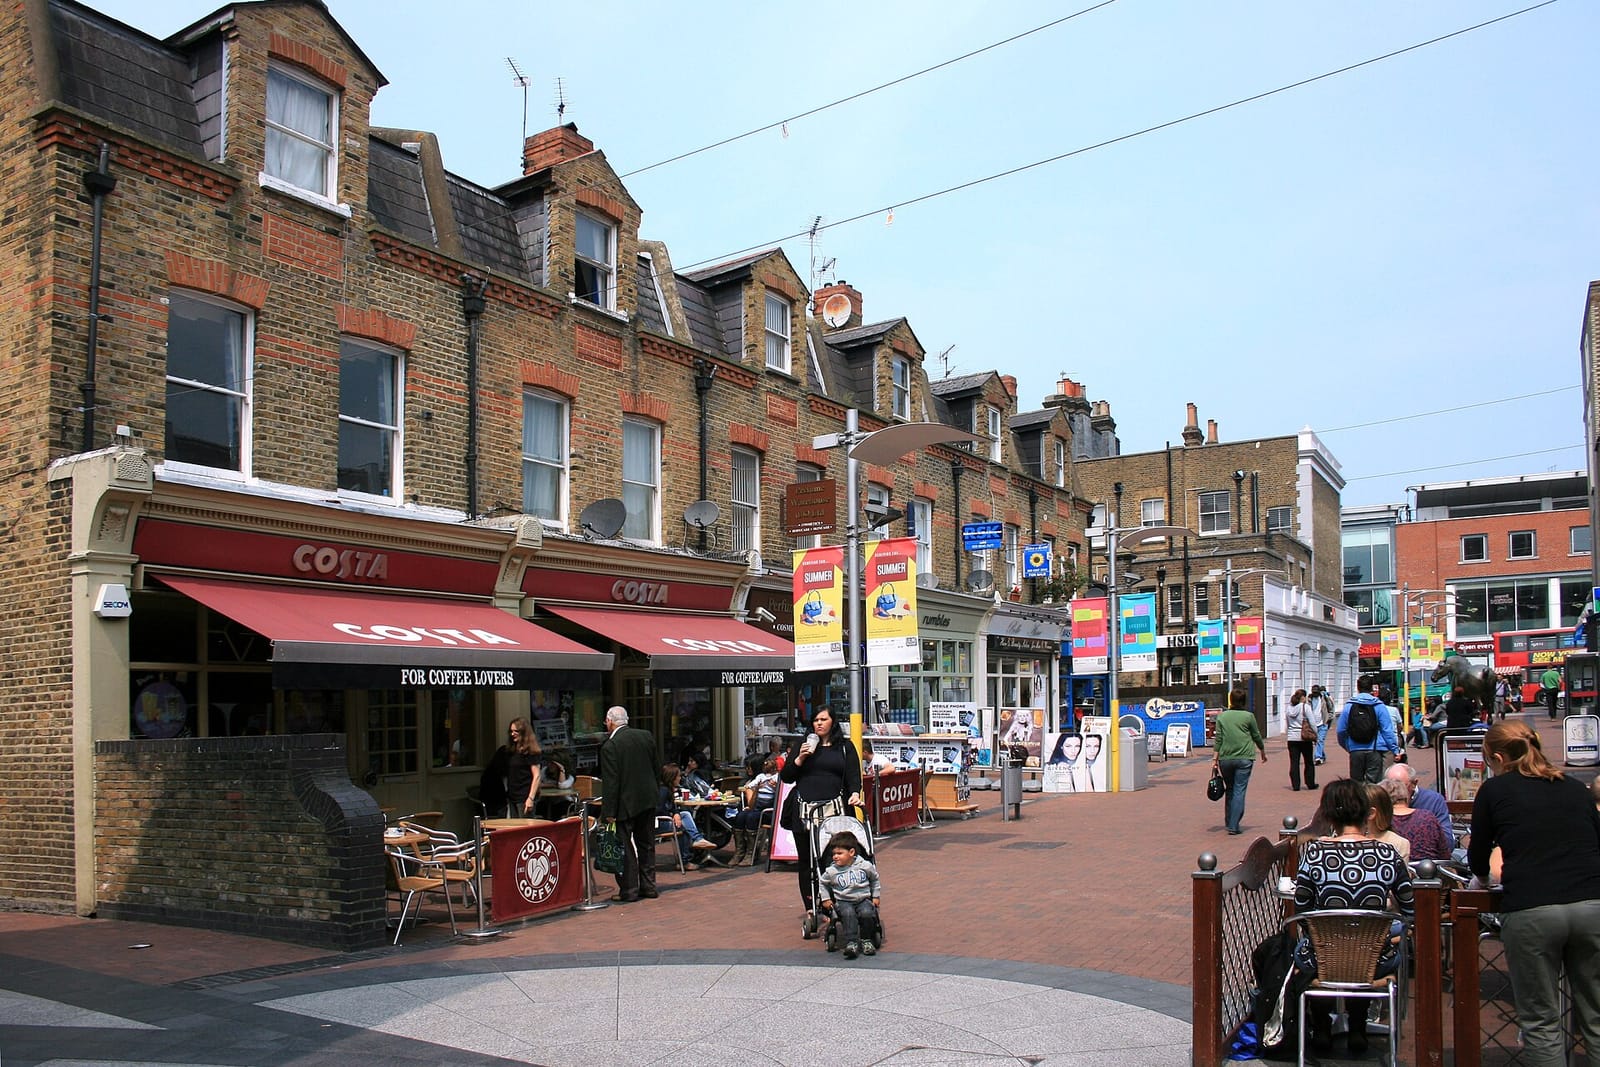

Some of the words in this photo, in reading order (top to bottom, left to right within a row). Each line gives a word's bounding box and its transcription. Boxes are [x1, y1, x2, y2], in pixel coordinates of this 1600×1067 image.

[293, 544, 388, 579] COSTA
[877, 562, 905, 576] SUMMER
[804, 570, 832, 583] SUMMER
[611, 579, 669, 604] COSTA
[922, 613, 951, 627] rumbles
[332, 623, 520, 645] COSTA
[661, 638, 776, 653] COSTA
[401, 669, 426, 685] FOR
[429, 669, 472, 686] COFFEE
[475, 671, 514, 686] LOVERS
[721, 672, 735, 684] FOR
[735, 672, 760, 684] COFFEE
[761, 671, 785, 683] LOVERS
[883, 783, 913, 802] COSTA
[521, 839, 552, 860] COSTA
[520, 874, 556, 900] COFFEE
